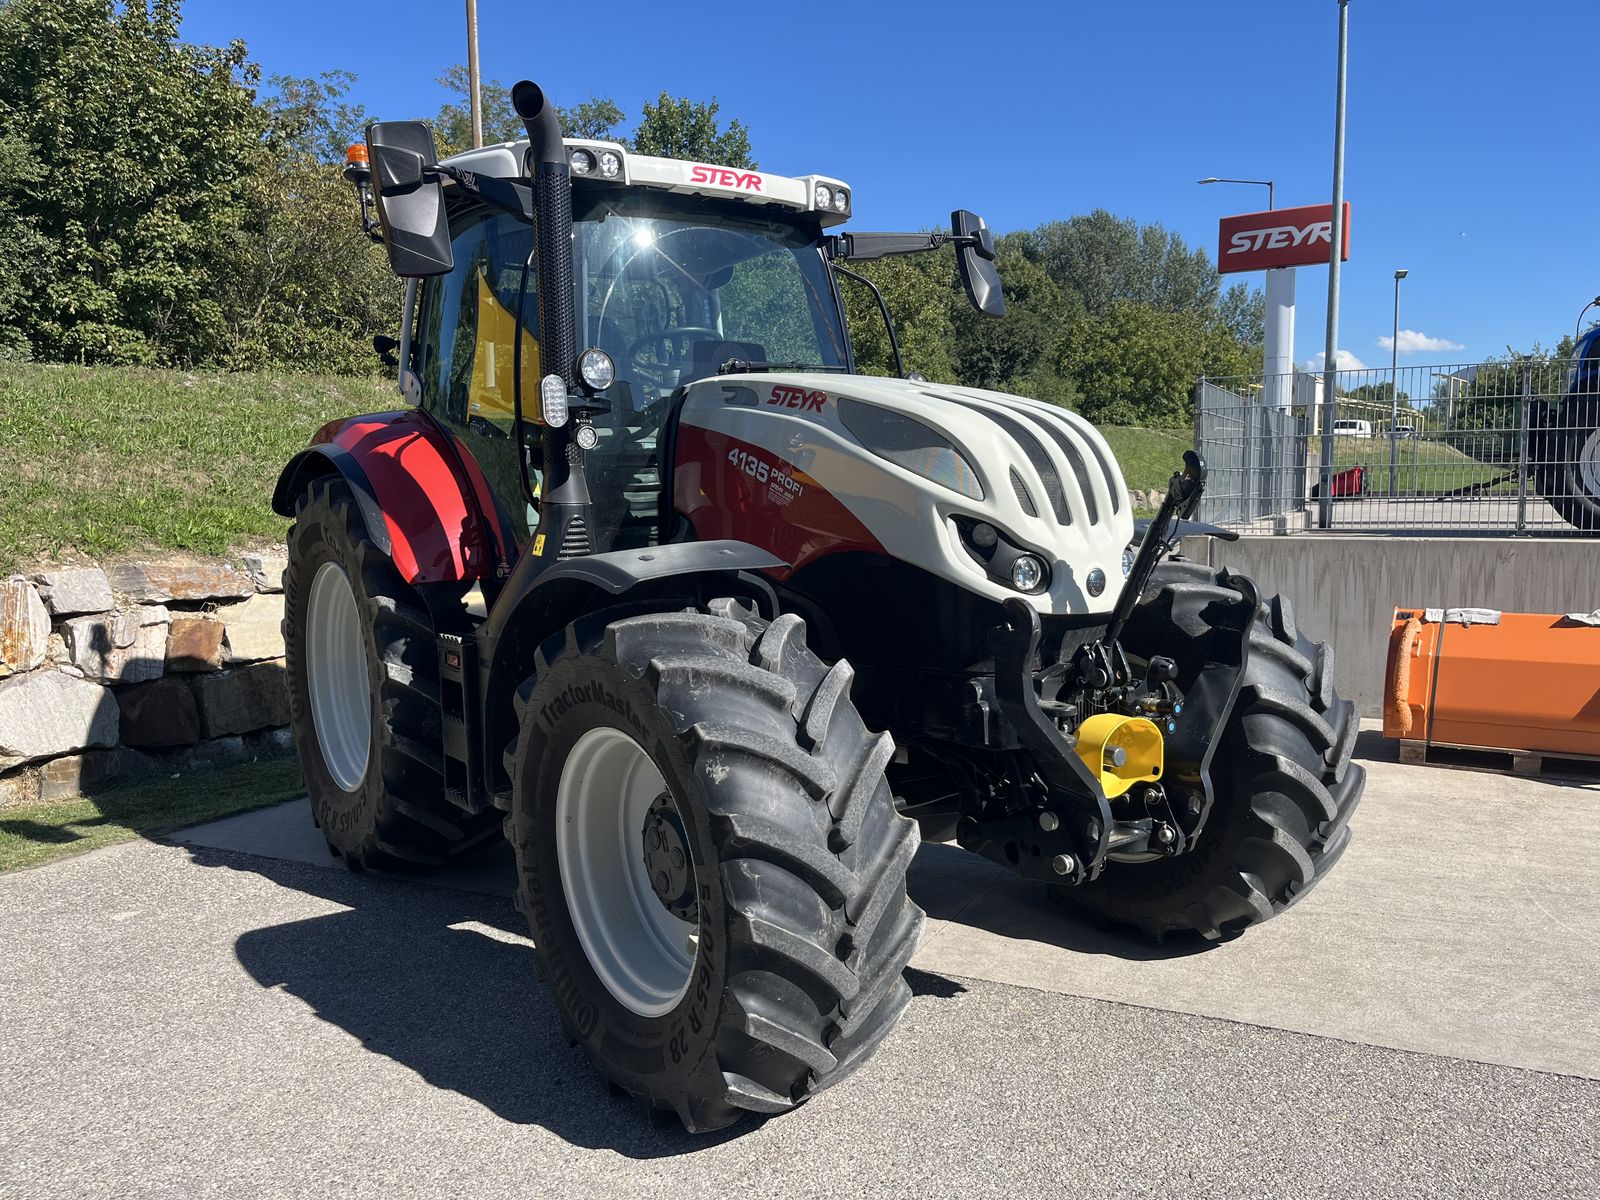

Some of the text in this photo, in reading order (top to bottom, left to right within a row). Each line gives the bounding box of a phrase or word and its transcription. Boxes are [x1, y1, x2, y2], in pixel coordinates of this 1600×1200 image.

[690, 165, 762, 192] STEYR
[1226, 221, 1333, 255] STEYR
[766, 385, 827, 413] STEYR
[728, 448, 769, 483] 4135
[770, 467, 803, 497] PROFI
[540, 680, 651, 741] TractorMaster
[669, 884, 714, 1065] 540/65 R 28
